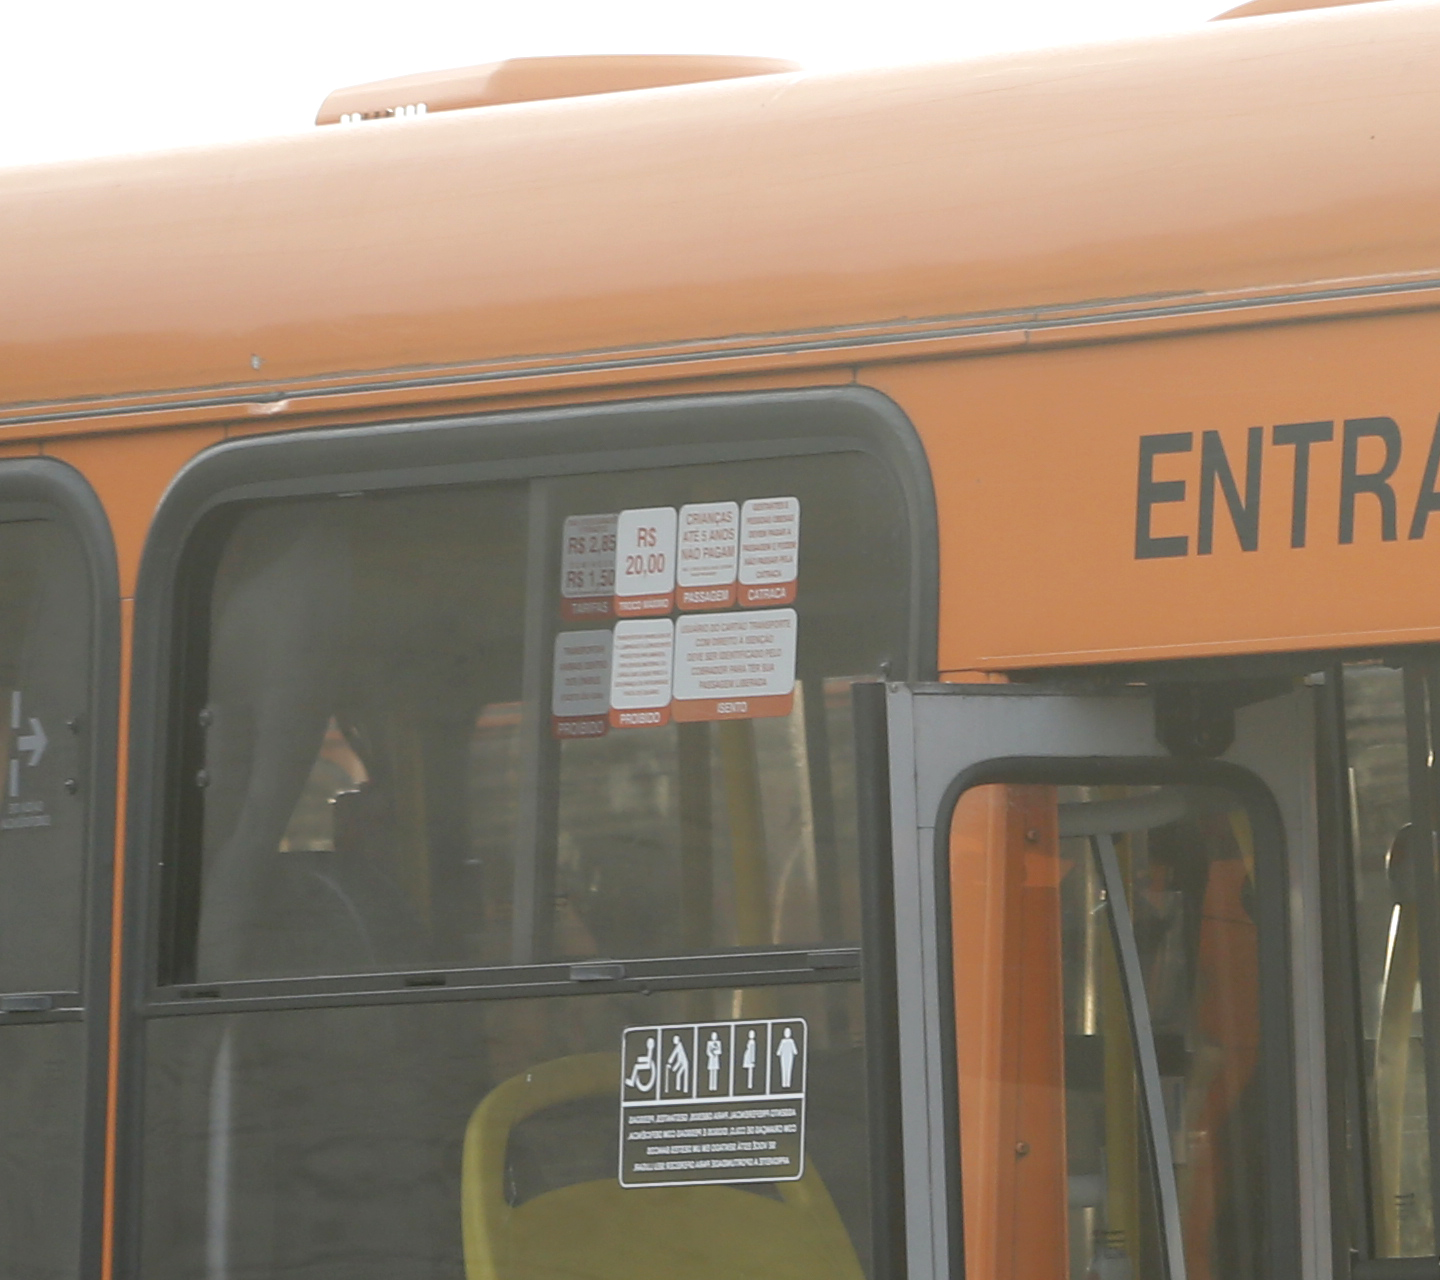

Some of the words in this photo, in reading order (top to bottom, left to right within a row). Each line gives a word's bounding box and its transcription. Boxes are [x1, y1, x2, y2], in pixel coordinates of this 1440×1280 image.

[625, 554, 665, 576] 20,00
[683, 589, 729, 603] PASSAGEM
[747, 587, 787, 601] CATRACA
[620, 712, 661, 724] PROIBIDO
